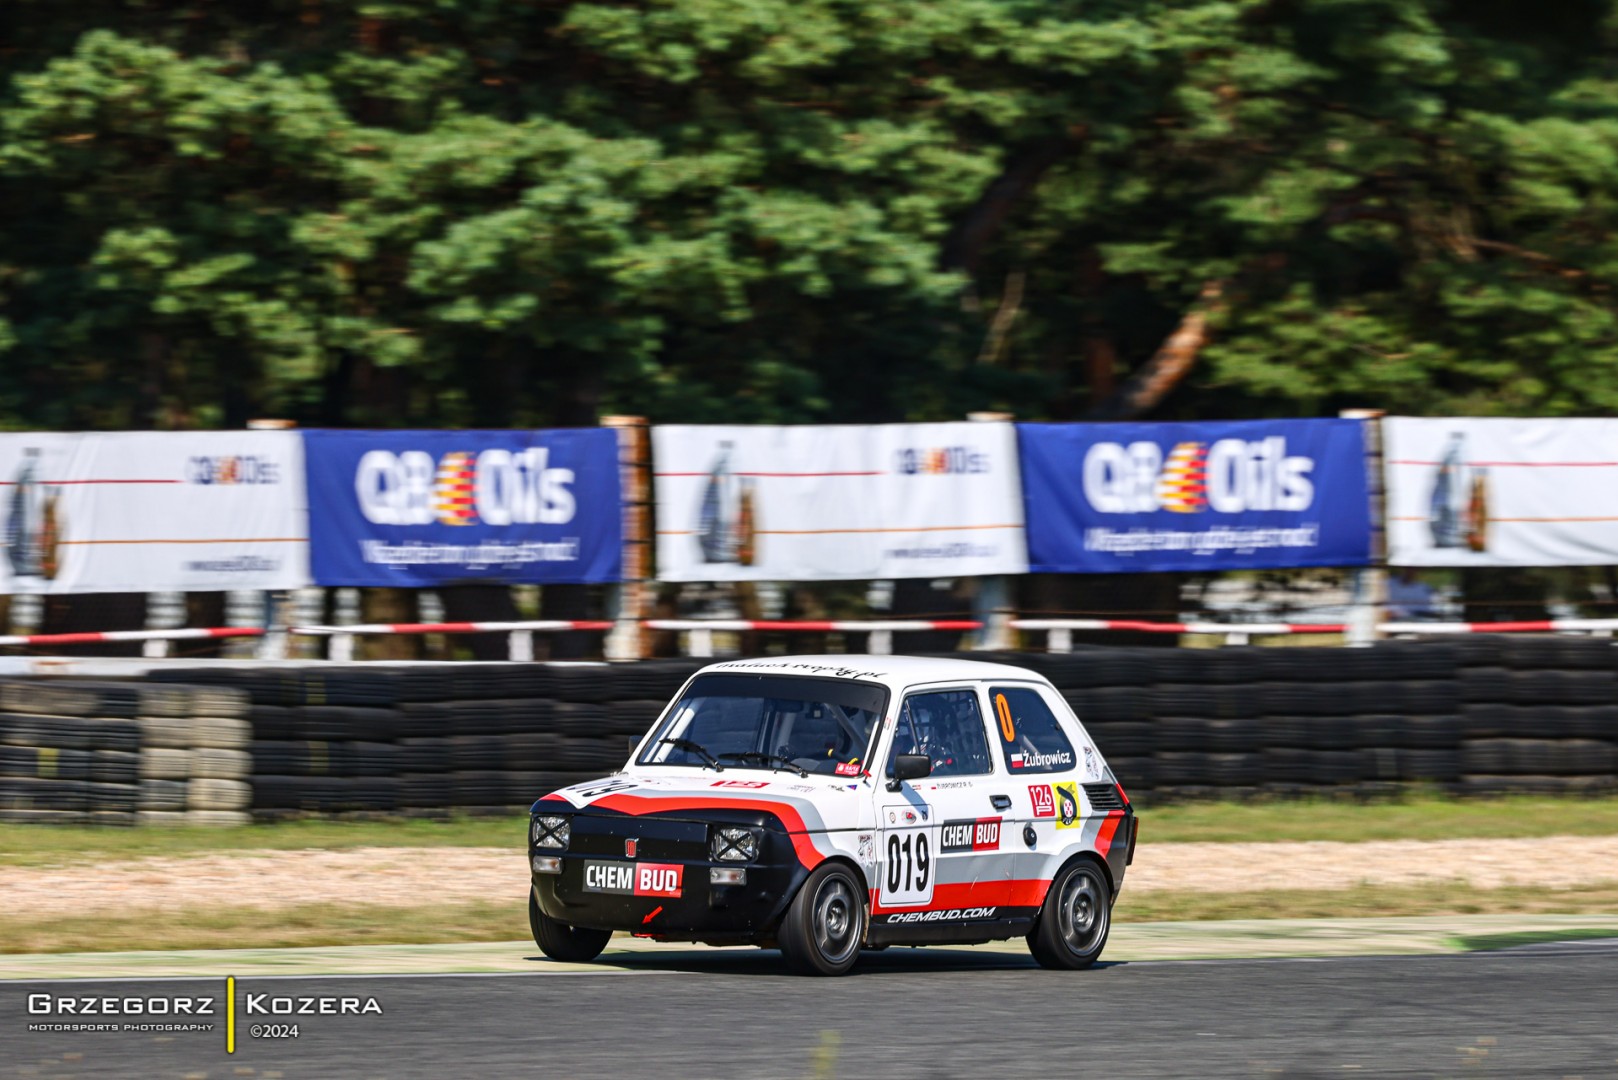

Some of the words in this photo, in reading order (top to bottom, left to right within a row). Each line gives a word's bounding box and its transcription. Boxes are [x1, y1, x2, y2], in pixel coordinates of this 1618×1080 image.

[475, 447, 576, 526] Oils
[1207, 436, 1315, 513] Oils
[996, 693, 1015, 743] 0
[1023, 750, 1072, 768] Żubrowicz
[1030, 786, 1052, 806] 126
[942, 824, 973, 847] CHEM
[976, 822, 998, 844] BUD
[887, 832, 930, 894] 019
[585, 865, 634, 891] CHEM
[639, 867, 679, 893] BUD
[887, 906, 996, 924] CHEMBUD.COM
